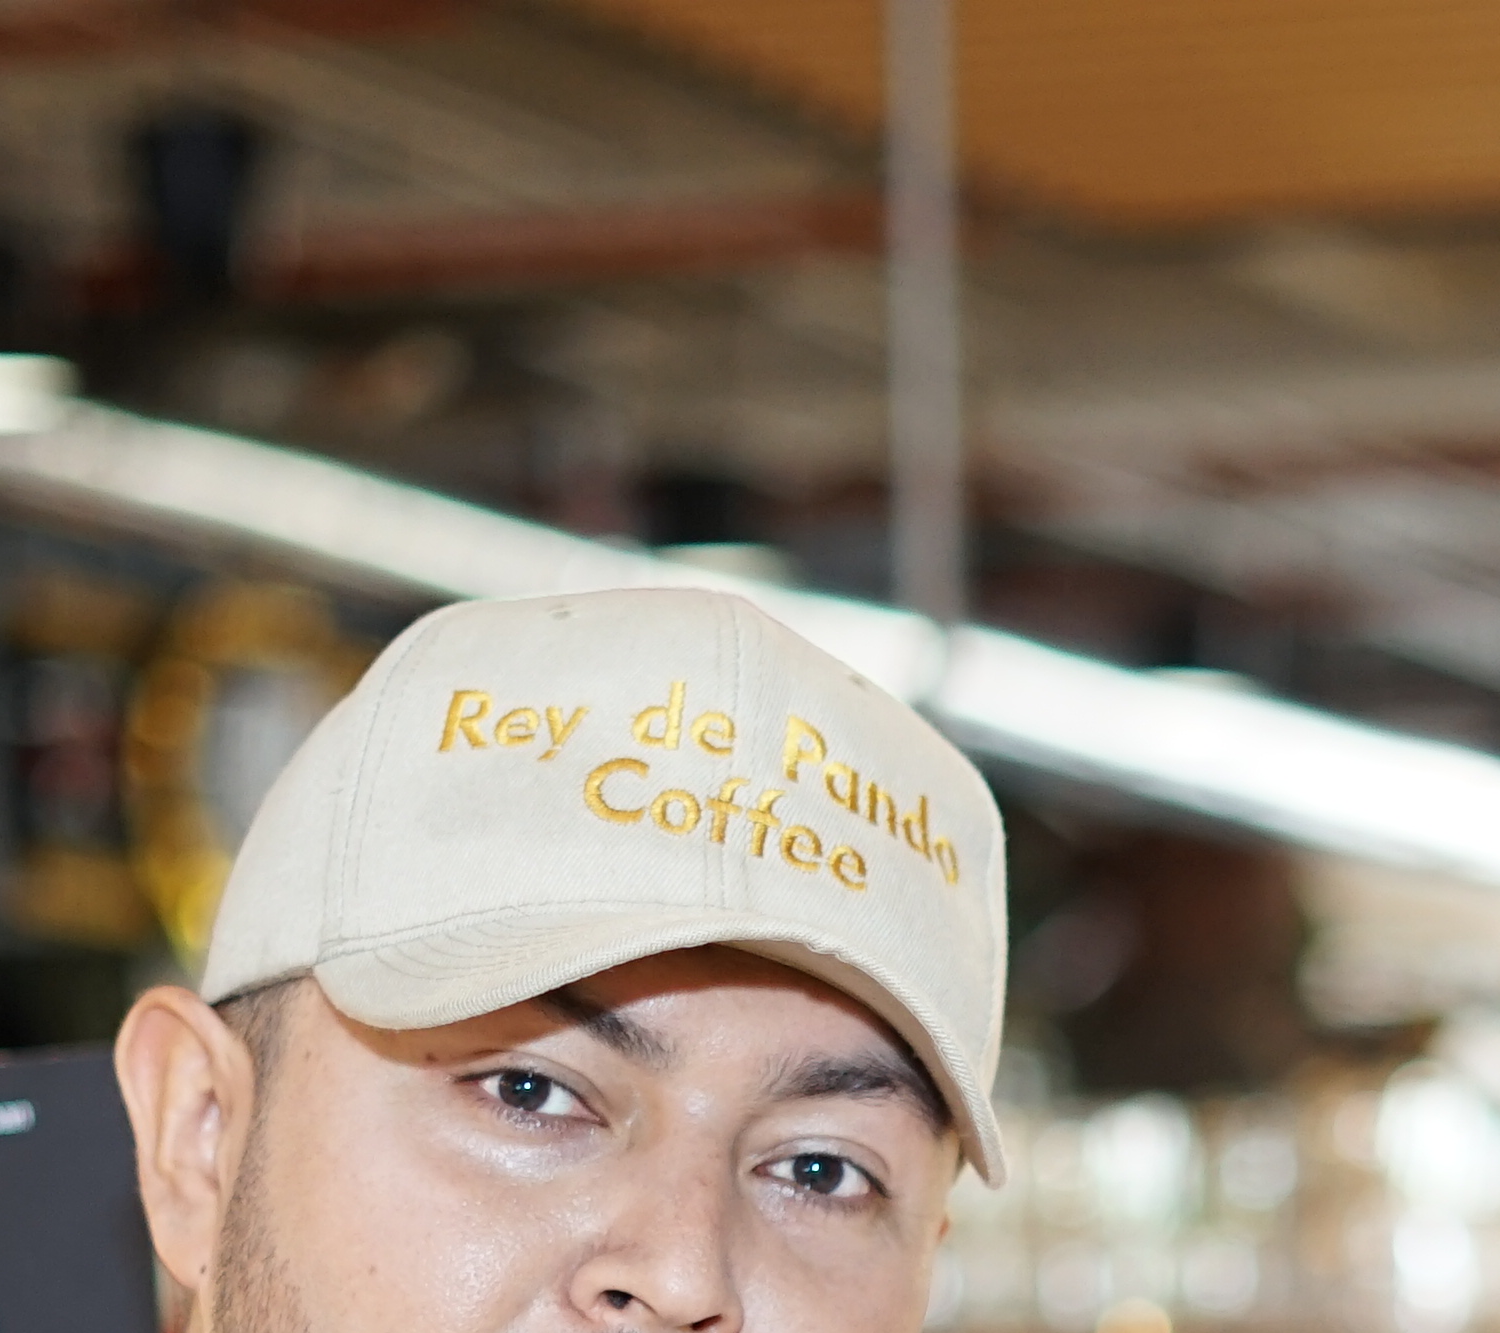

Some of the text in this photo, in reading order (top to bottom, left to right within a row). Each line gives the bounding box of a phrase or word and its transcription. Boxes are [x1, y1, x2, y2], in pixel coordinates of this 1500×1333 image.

[437, 680, 961, 886] Rey de Pando
[583, 756, 869, 893] Coffee
